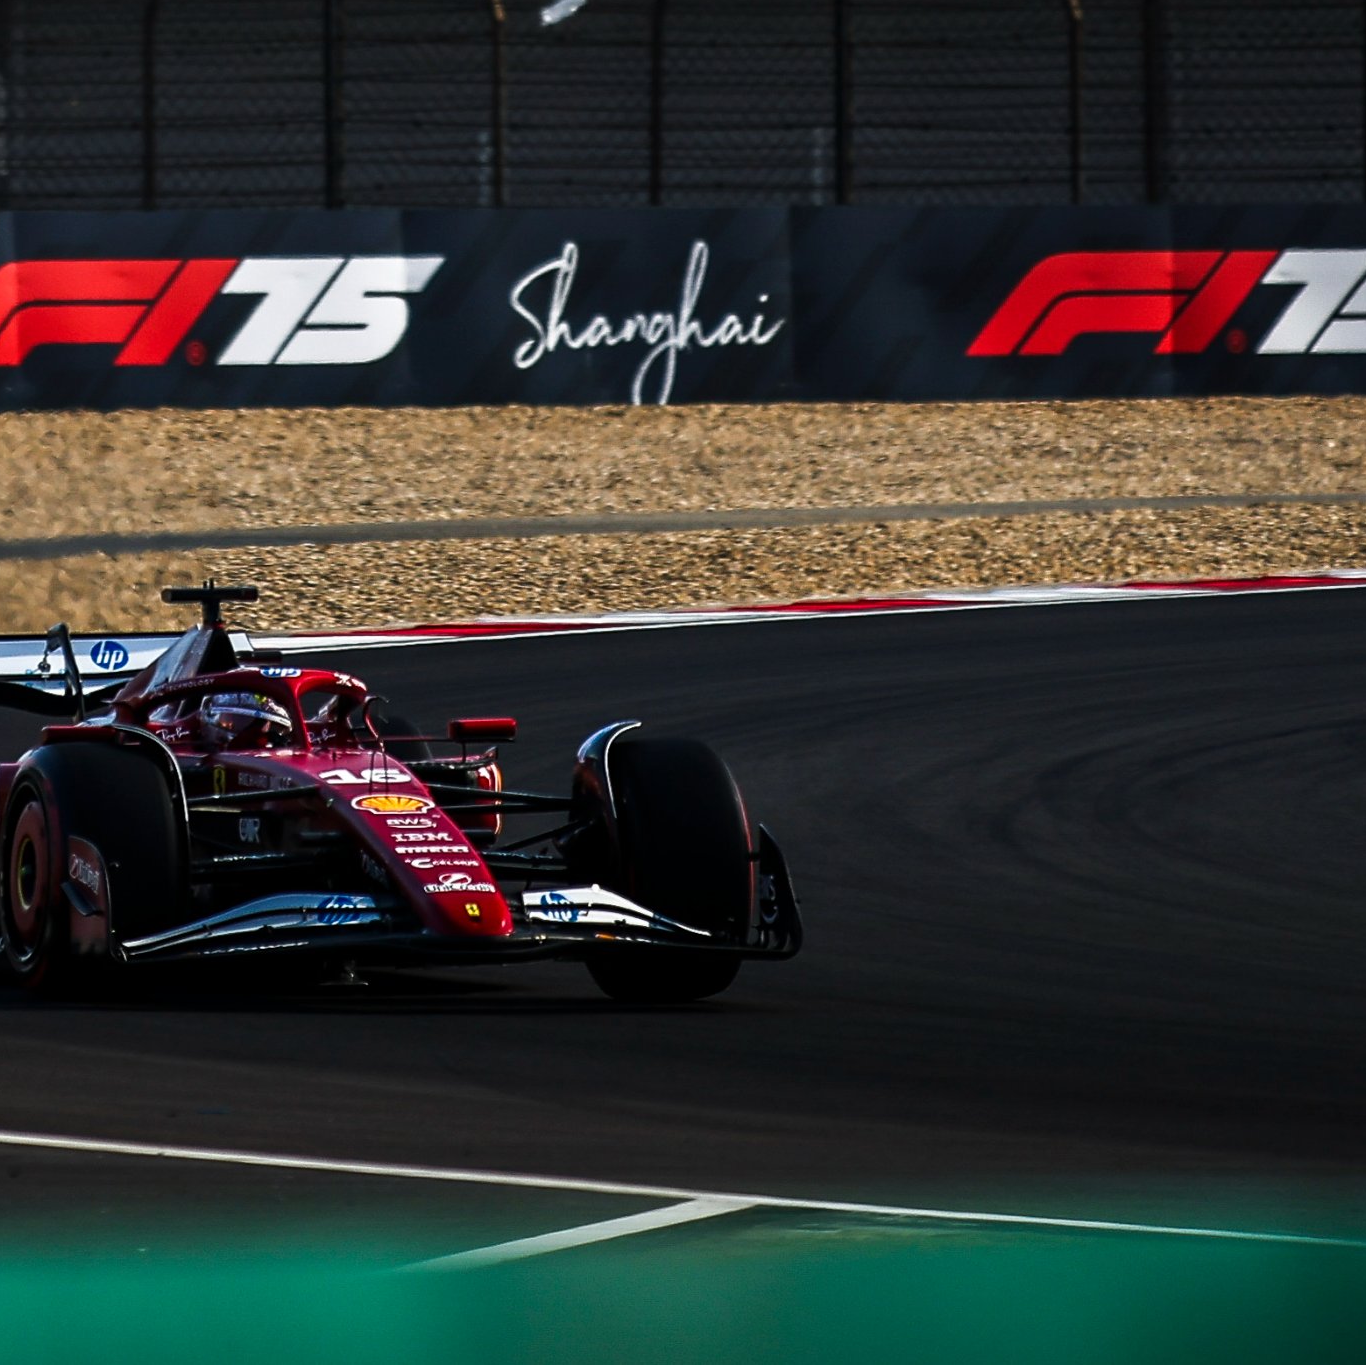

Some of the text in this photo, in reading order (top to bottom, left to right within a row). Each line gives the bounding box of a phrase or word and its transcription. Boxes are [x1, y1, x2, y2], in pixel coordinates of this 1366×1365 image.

[510, 240, 785, 405] Shanghai
[97, 641, 124, 670] hp
[319, 768, 412, 785] 16
[391, 832, 453, 842] IBM
